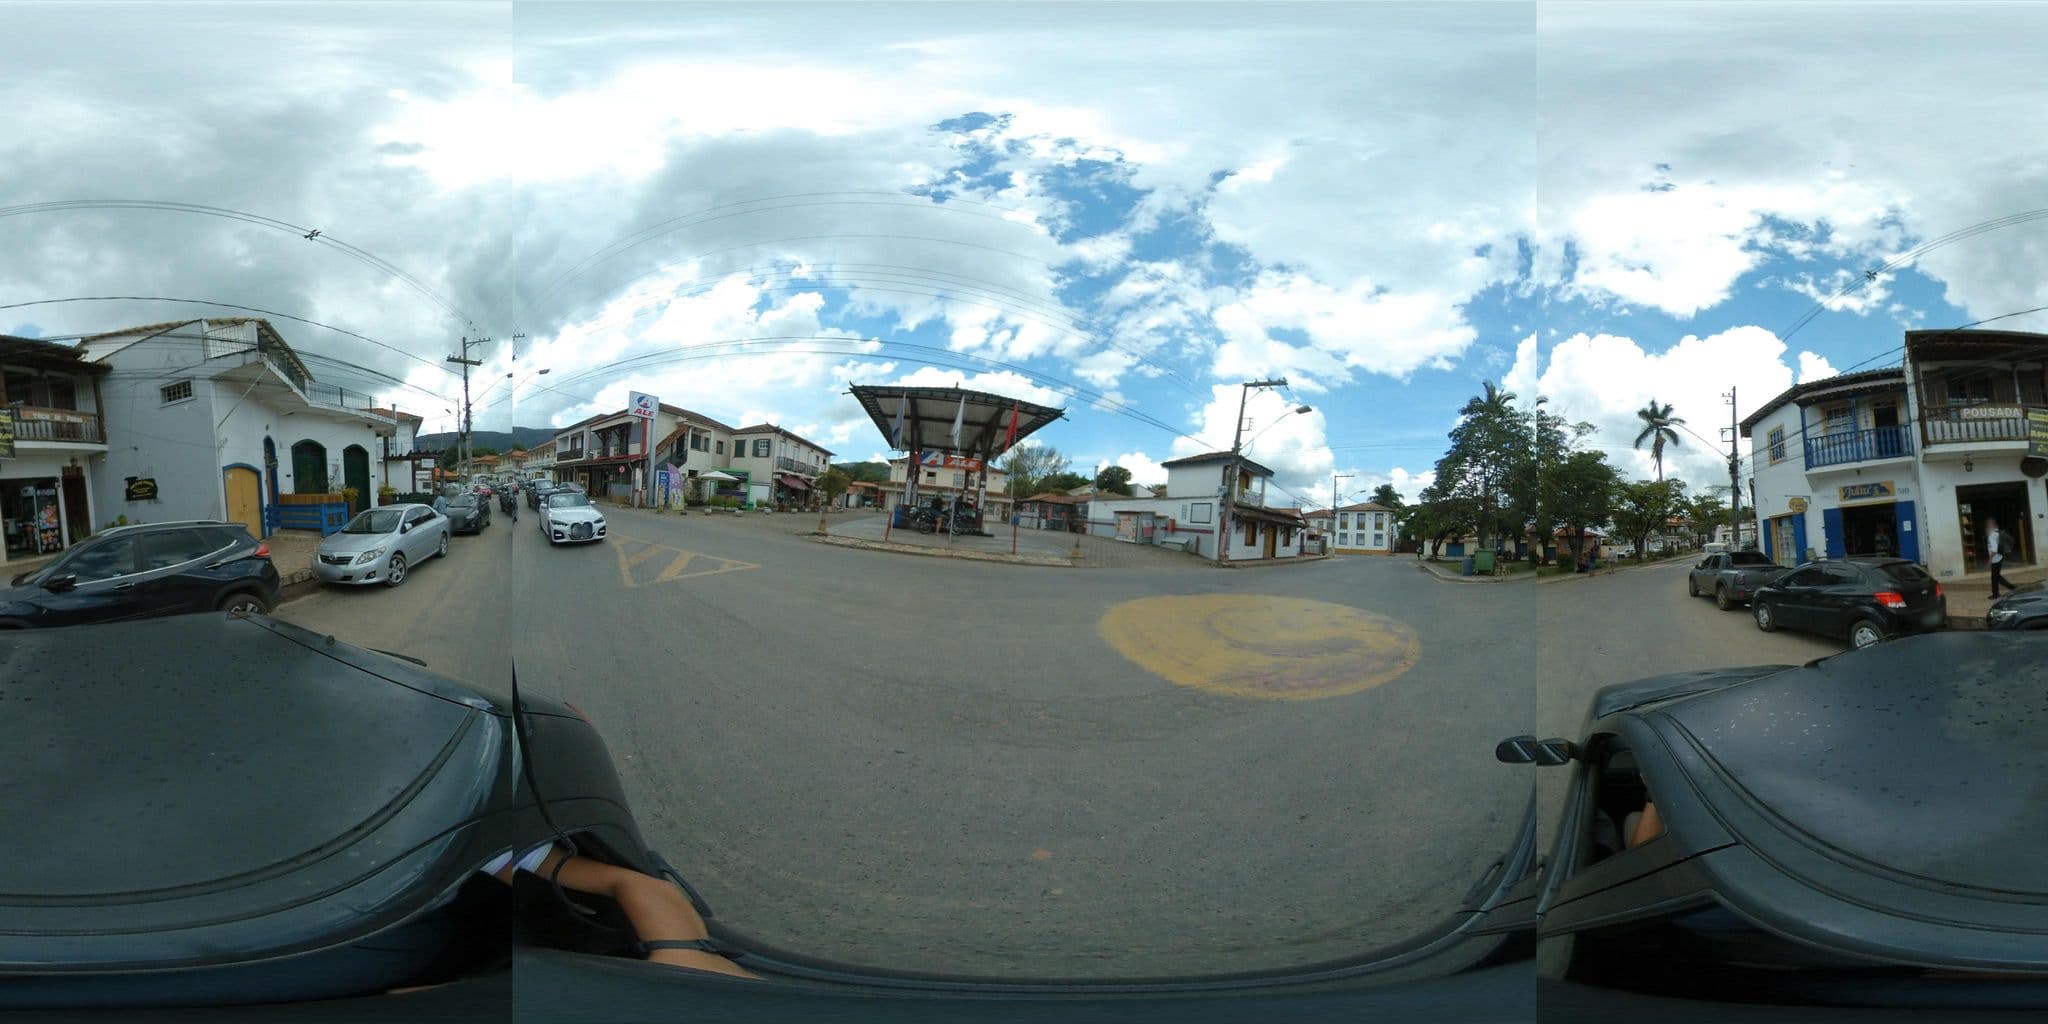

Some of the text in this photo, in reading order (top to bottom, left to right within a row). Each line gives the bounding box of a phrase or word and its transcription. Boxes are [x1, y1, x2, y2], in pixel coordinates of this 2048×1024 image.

[634, 408, 655, 417] ALE
[1963, 407, 2020, 417] POUSADA
[950, 458, 977, 467] ALE
